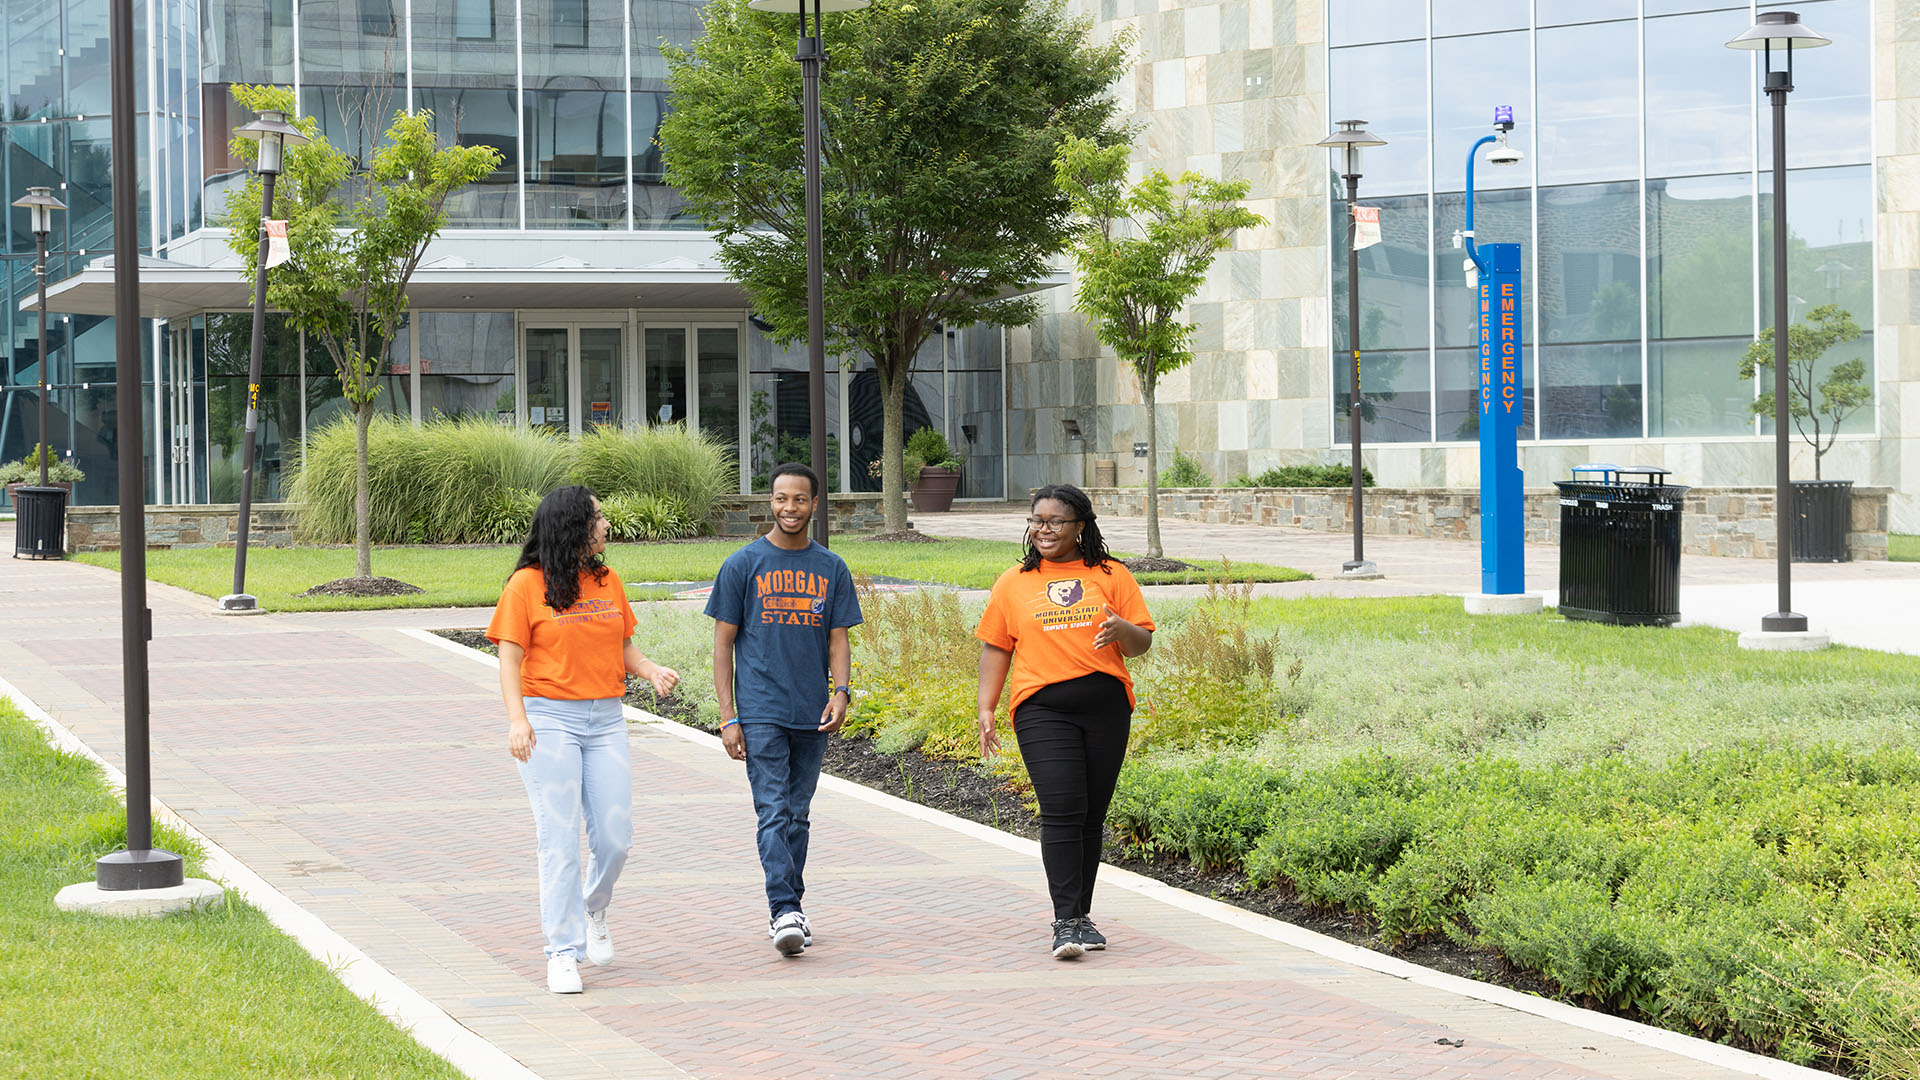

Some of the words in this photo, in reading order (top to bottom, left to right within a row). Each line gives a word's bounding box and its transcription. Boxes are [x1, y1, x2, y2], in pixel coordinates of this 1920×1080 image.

[1481, 285, 1490, 414] EMERGENCY
[1501, 283, 1515, 413] EMERGENCY
[756, 570, 829, 601] MORGAN
[761, 611, 822, 626] STATE
[1035, 609, 1071, 619] MORGAN
[1075, 606, 1099, 614] STATE
[1043, 614, 1092, 624] UNIVERSITY
